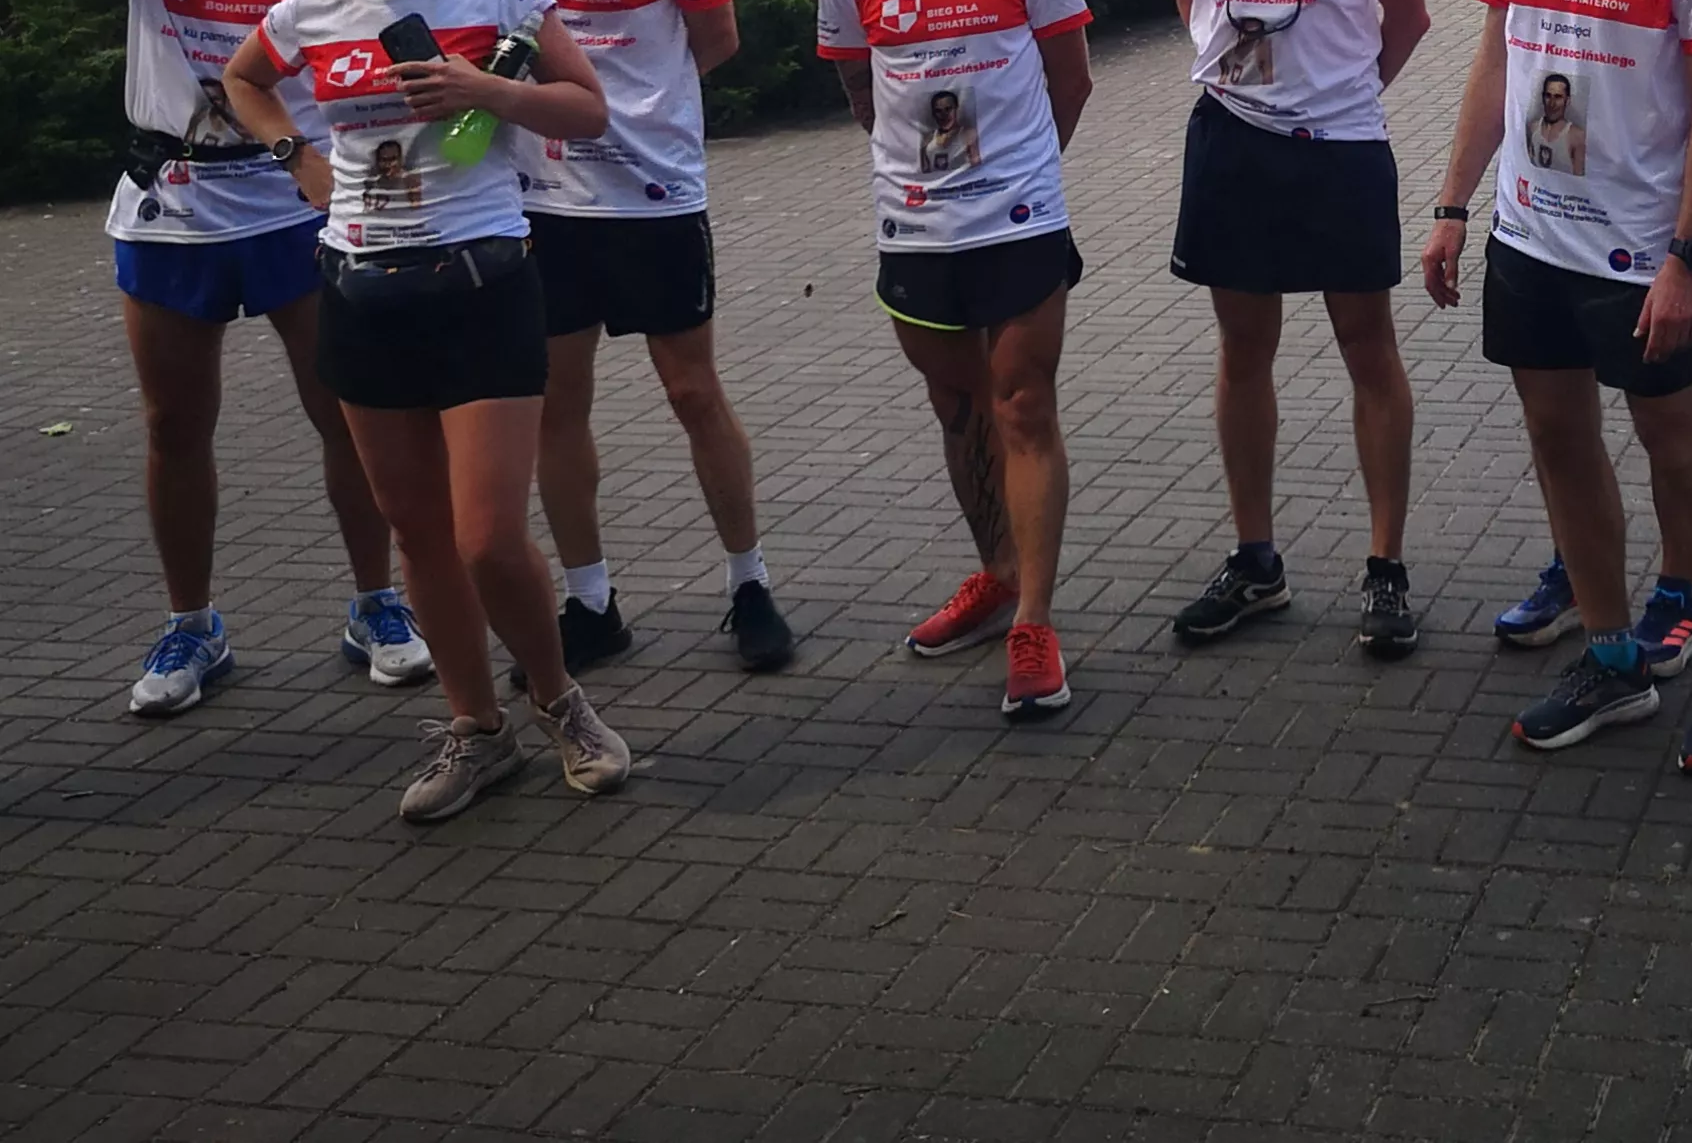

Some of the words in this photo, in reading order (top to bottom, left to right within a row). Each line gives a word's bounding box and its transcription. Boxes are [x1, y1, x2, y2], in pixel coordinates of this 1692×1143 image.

[926, 7, 953, 18] BIEG
[956, 3, 978, 14] DLA
[928, 14, 999, 32] BOHATERÓW
[924, 57, 1009, 79] Kusocińskiego
